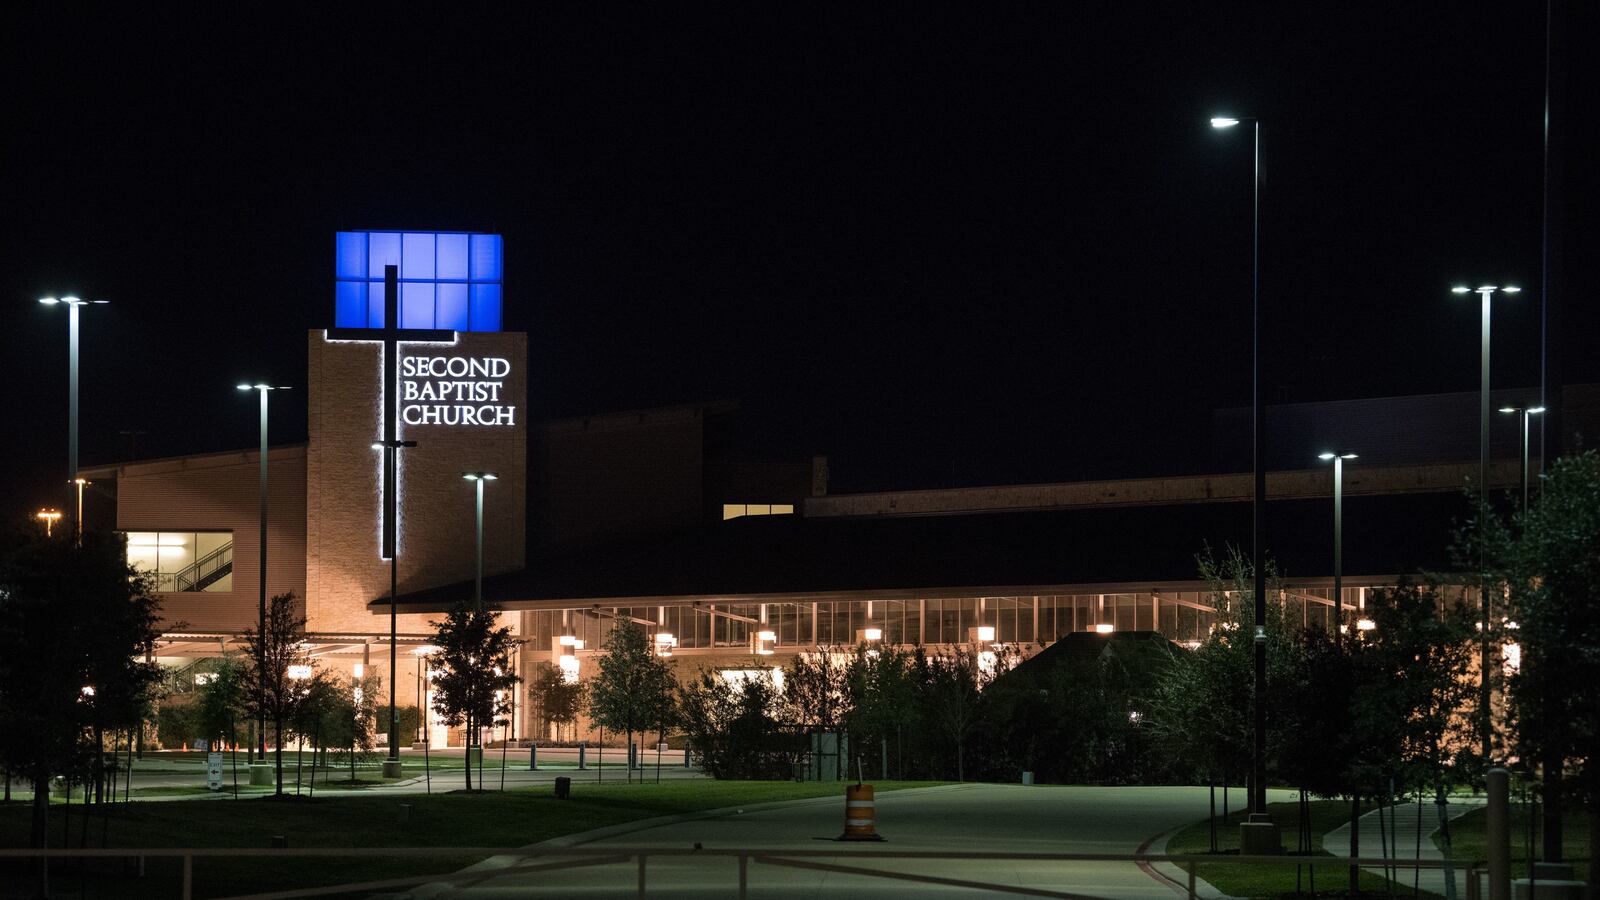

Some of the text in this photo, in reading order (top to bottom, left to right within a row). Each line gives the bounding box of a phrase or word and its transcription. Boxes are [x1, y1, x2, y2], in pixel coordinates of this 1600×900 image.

[403, 357, 511, 377] SECOND
[404, 381, 502, 401] BAPTIST
[403, 405, 515, 425] CHURCH
